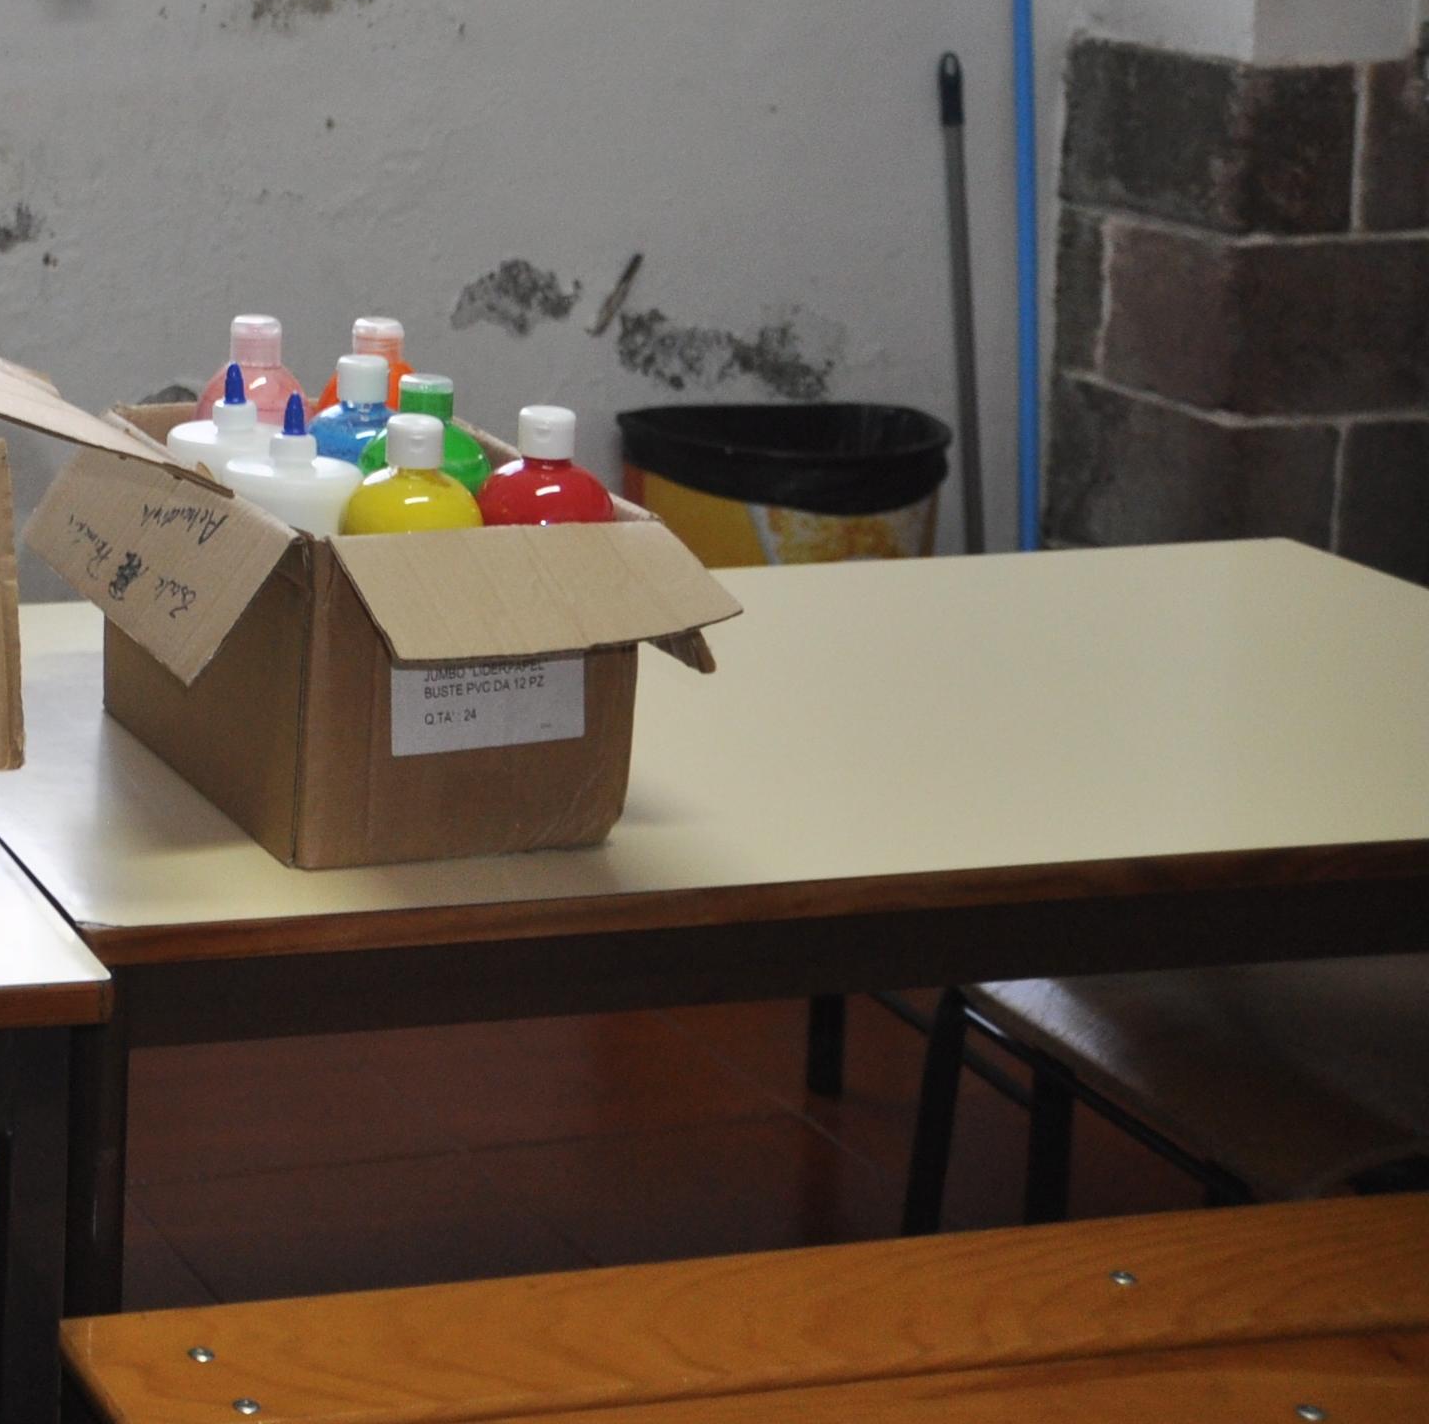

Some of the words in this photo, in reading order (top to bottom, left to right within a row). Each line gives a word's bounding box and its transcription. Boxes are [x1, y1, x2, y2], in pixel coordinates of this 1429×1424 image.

[424, 683, 463, 699] BUSTE
[466, 681, 491, 695] PVC
[494, 679, 510, 692] DA
[514, 677, 527, 690] 12
[529, 675, 545, 688] PZ
[463, 709, 477, 722] 24
